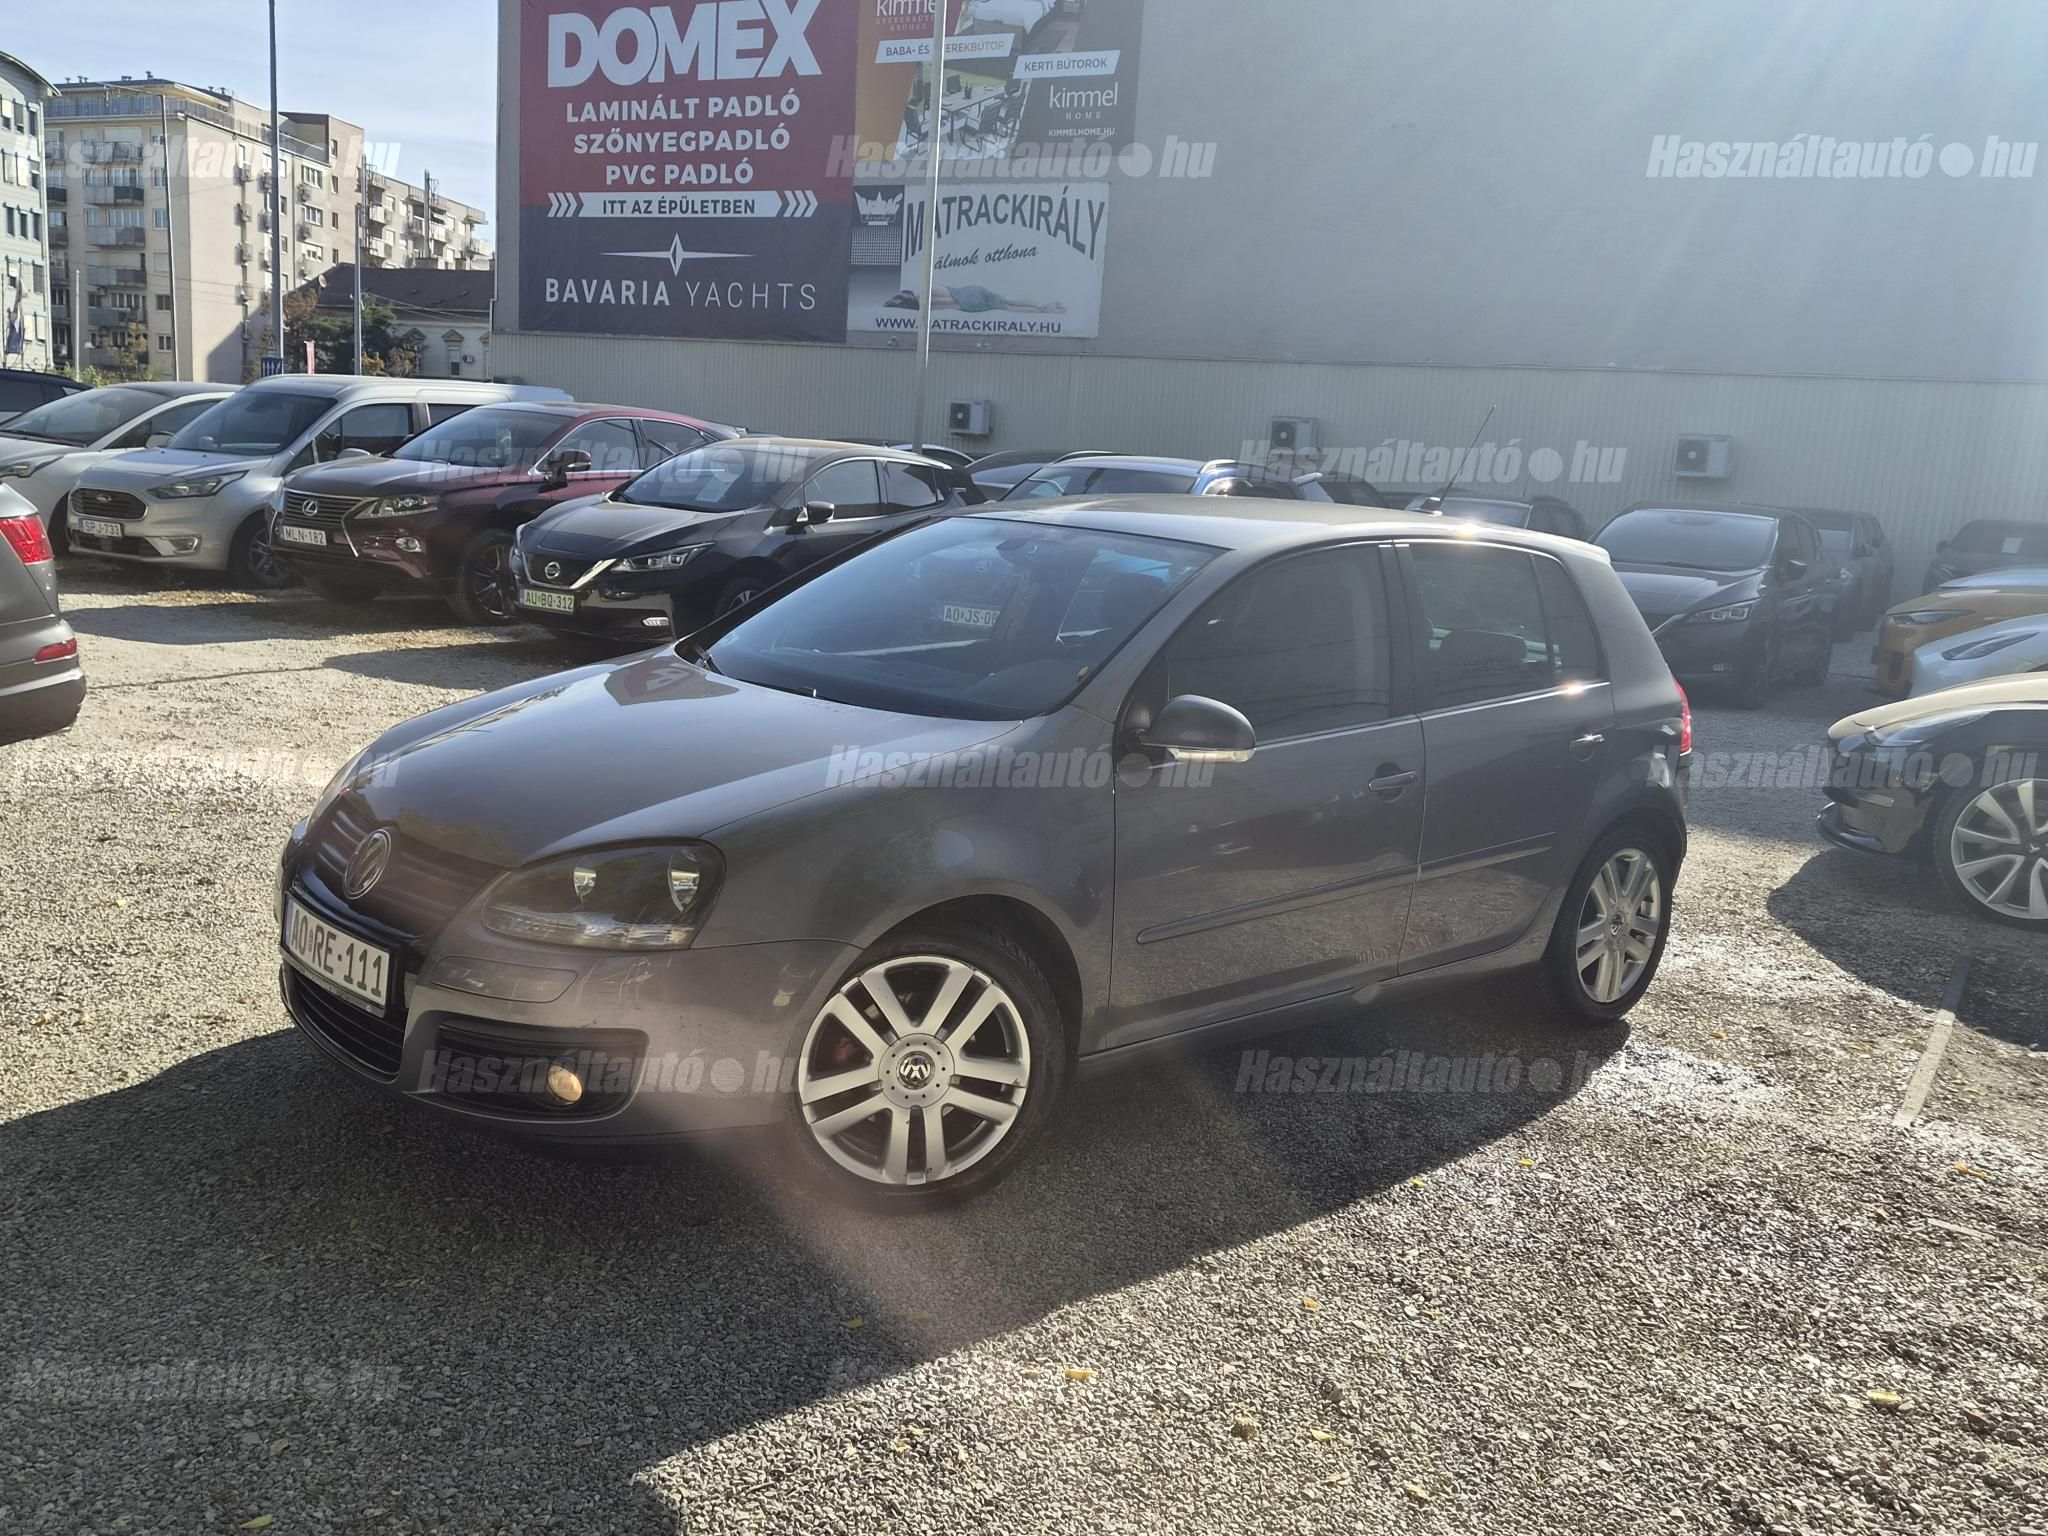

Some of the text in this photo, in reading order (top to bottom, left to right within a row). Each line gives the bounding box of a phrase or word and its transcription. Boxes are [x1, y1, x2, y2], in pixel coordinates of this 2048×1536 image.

[876, 0, 937, 17] kimme
[548, 0, 822, 87] DOMEX
[885, 40, 1005, 57] BABA- ÉS EREKBÚTOR
[1024, 57, 1108, 72] KERTI BÚTOROK
[1048, 81, 1119, 109] kimmel
[566, 88, 800, 123] LAMINÁLT PADLÓ
[1065, 111, 1102, 121] HOME
[574, 122, 790, 154] SZŐNYEGPADLÓ
[606, 157, 754, 185] PVC PADLÓ
[602, 195, 755, 215] ITT AZ ÉPÜLETBEN
[984, 243, 1039, 263] otthona
[545, 278, 816, 310] BAVARIA YACHTS
[875, 317, 1061, 334] WWW.ATRACKIRALY.HU
